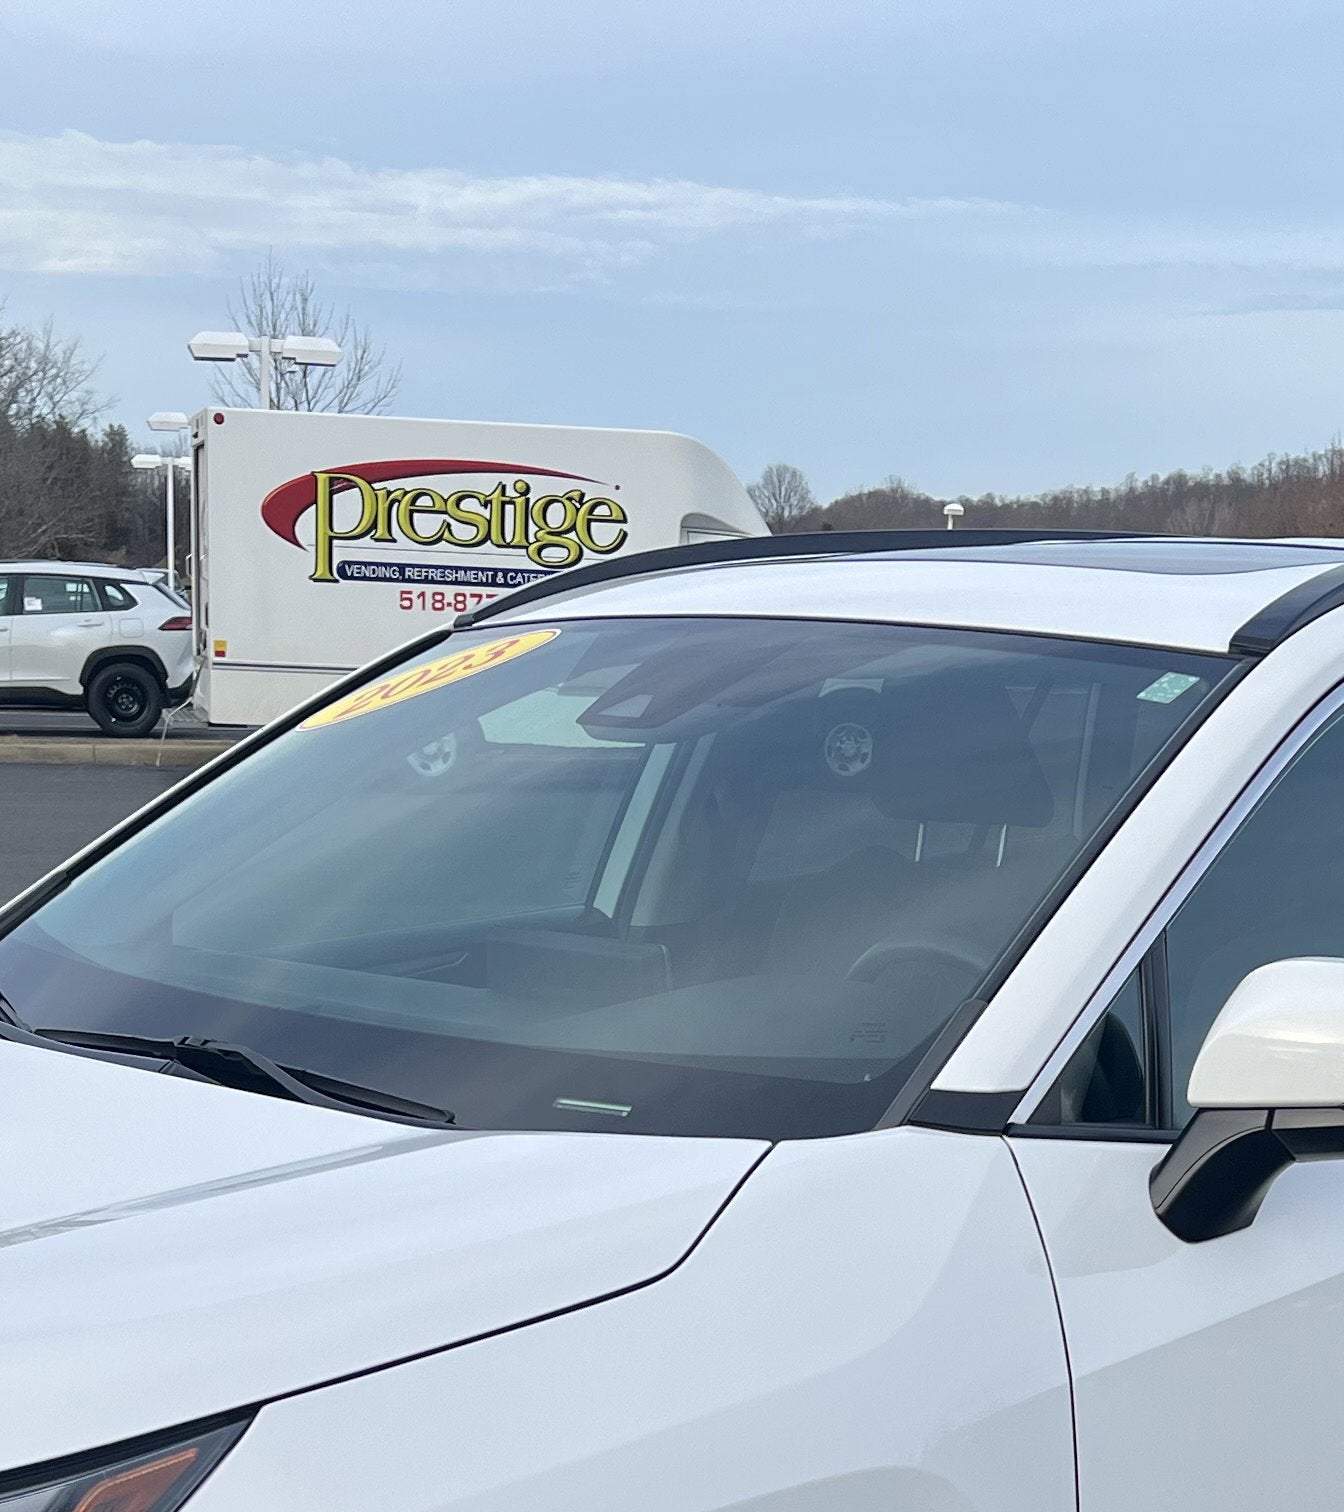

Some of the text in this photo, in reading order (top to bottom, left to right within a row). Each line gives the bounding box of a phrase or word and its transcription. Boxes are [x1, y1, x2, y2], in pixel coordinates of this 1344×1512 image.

[309, 471, 628, 583] Prestige
[344, 564, 403, 580] VENDING,
[404, 567, 494, 583] REFRESHMENT
[496, 572, 505, 584] &
[333, 638, 521, 719] 2023
